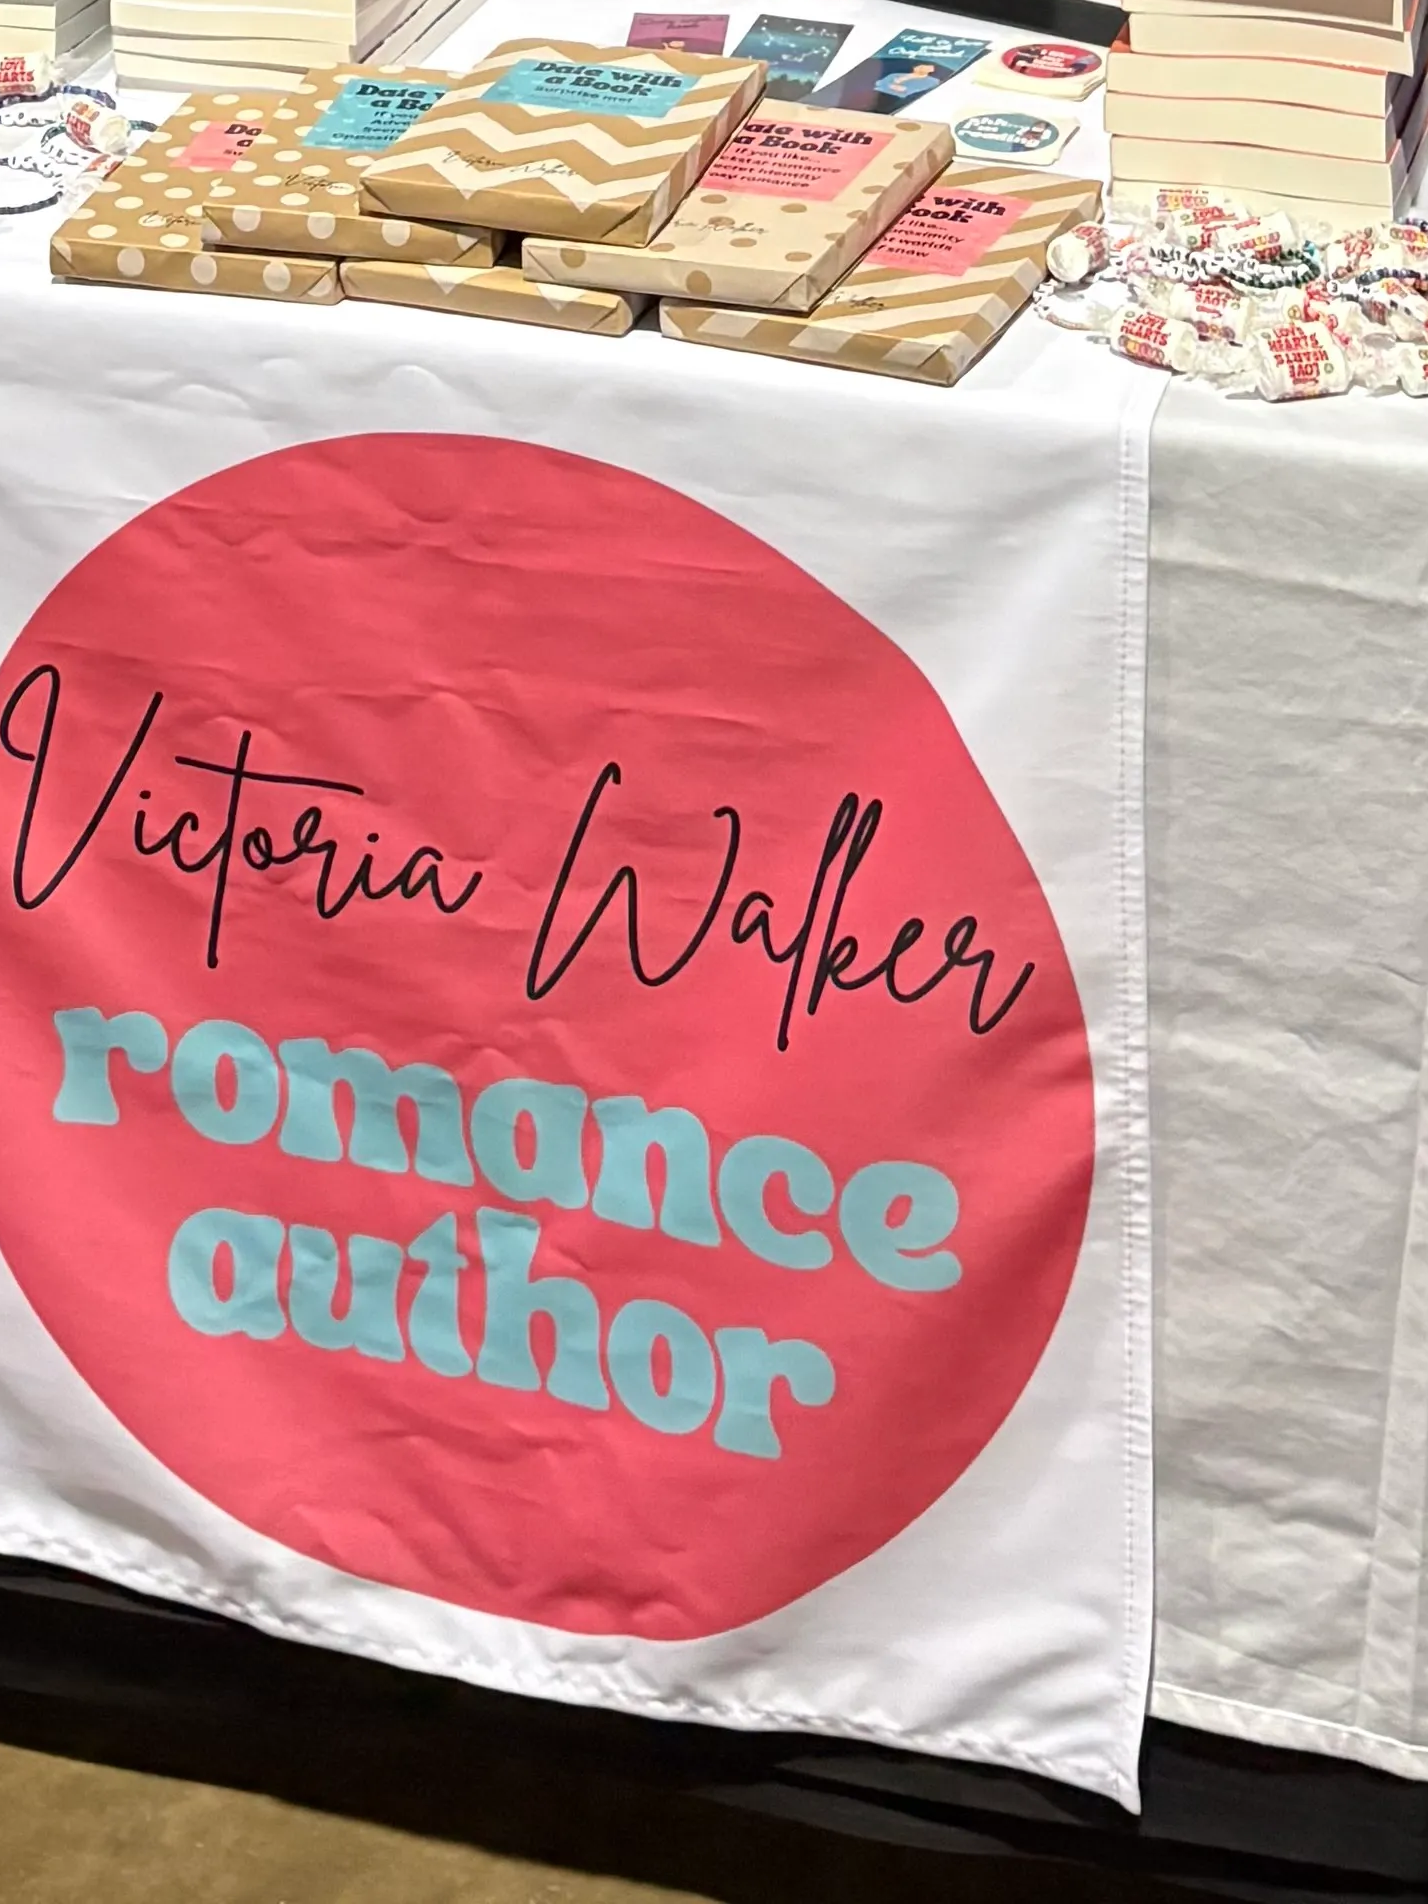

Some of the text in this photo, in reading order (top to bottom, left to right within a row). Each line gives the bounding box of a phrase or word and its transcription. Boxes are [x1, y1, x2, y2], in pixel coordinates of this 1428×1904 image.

[534, 62, 683, 88] Date with
[545, 75, 652, 96] a Book
[0, 664, 1033, 1050] Victoria Walker
[53, 1006, 963, 1292] romance
[169, 1207, 835, 1460] author
